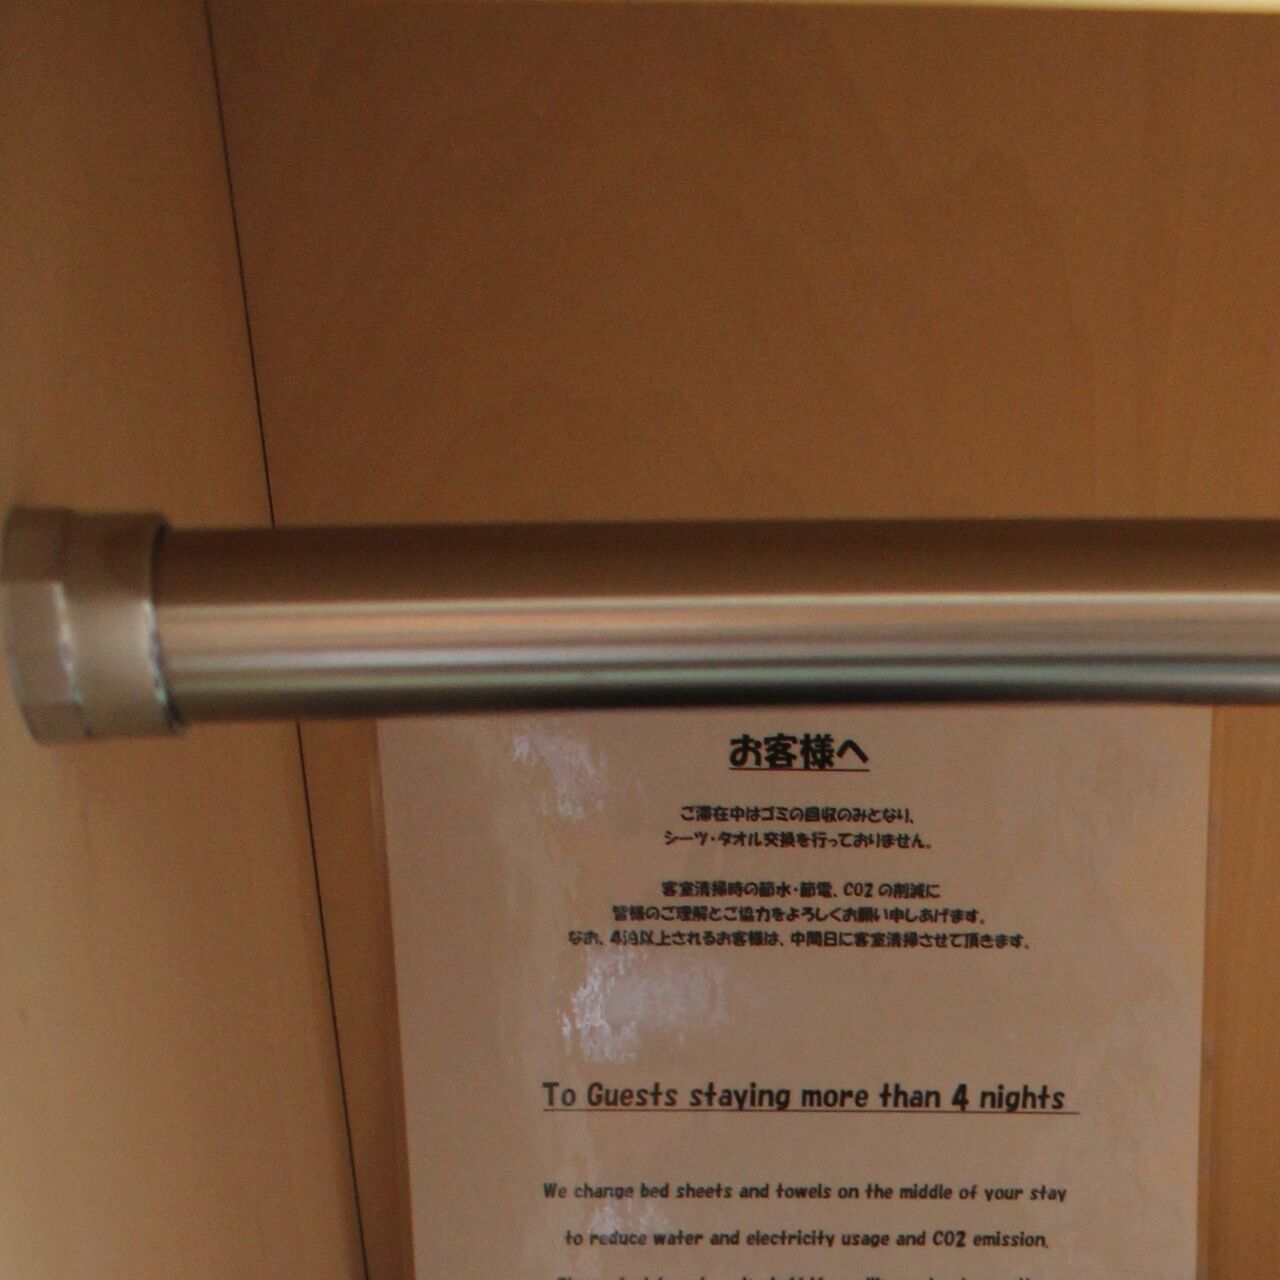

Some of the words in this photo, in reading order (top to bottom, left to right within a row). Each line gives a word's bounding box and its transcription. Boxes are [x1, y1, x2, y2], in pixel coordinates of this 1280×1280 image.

[729, 732, 869, 769] お客様へ
[542, 1081, 576, 1107] To
[587, 1081, 678, 1107] Guests
[689, 1081, 791, 1111] staying
[801, 1086, 868, 1109] more
[879, 1081, 941, 1110] than
[951, 1083, 970, 1110] 4
[980, 1083, 1065, 1113] nights
[543, 1182, 568, 1200] We
[574, 1182, 634, 1201] change
[640, 1182, 670, 1200] bed
[676, 1182, 733, 1200] sheets
[739, 1182, 770, 1200] and
[776, 1182, 832, 1200] towels
[838, 1187, 860, 1200] on
[865, 1182, 894, 1200] the
[900, 1182, 953, 1200] middle
[959, 1183, 979, 1201] of
[984, 1187, 1024, 1203] your
[1030, 1184, 1068, 1204] stay
[564, 1229, 584, 1246] to
[589, 1229, 647, 1246] reduce
[653, 1229, 704, 1246] water
[710, 1229, 740, 1246] and
[746, 1229, 835, 1249] electricity
[841, 1233, 890, 1249] usage
[896, 1229, 926, 1246] and
[932, 1230, 967, 1248] CO2
